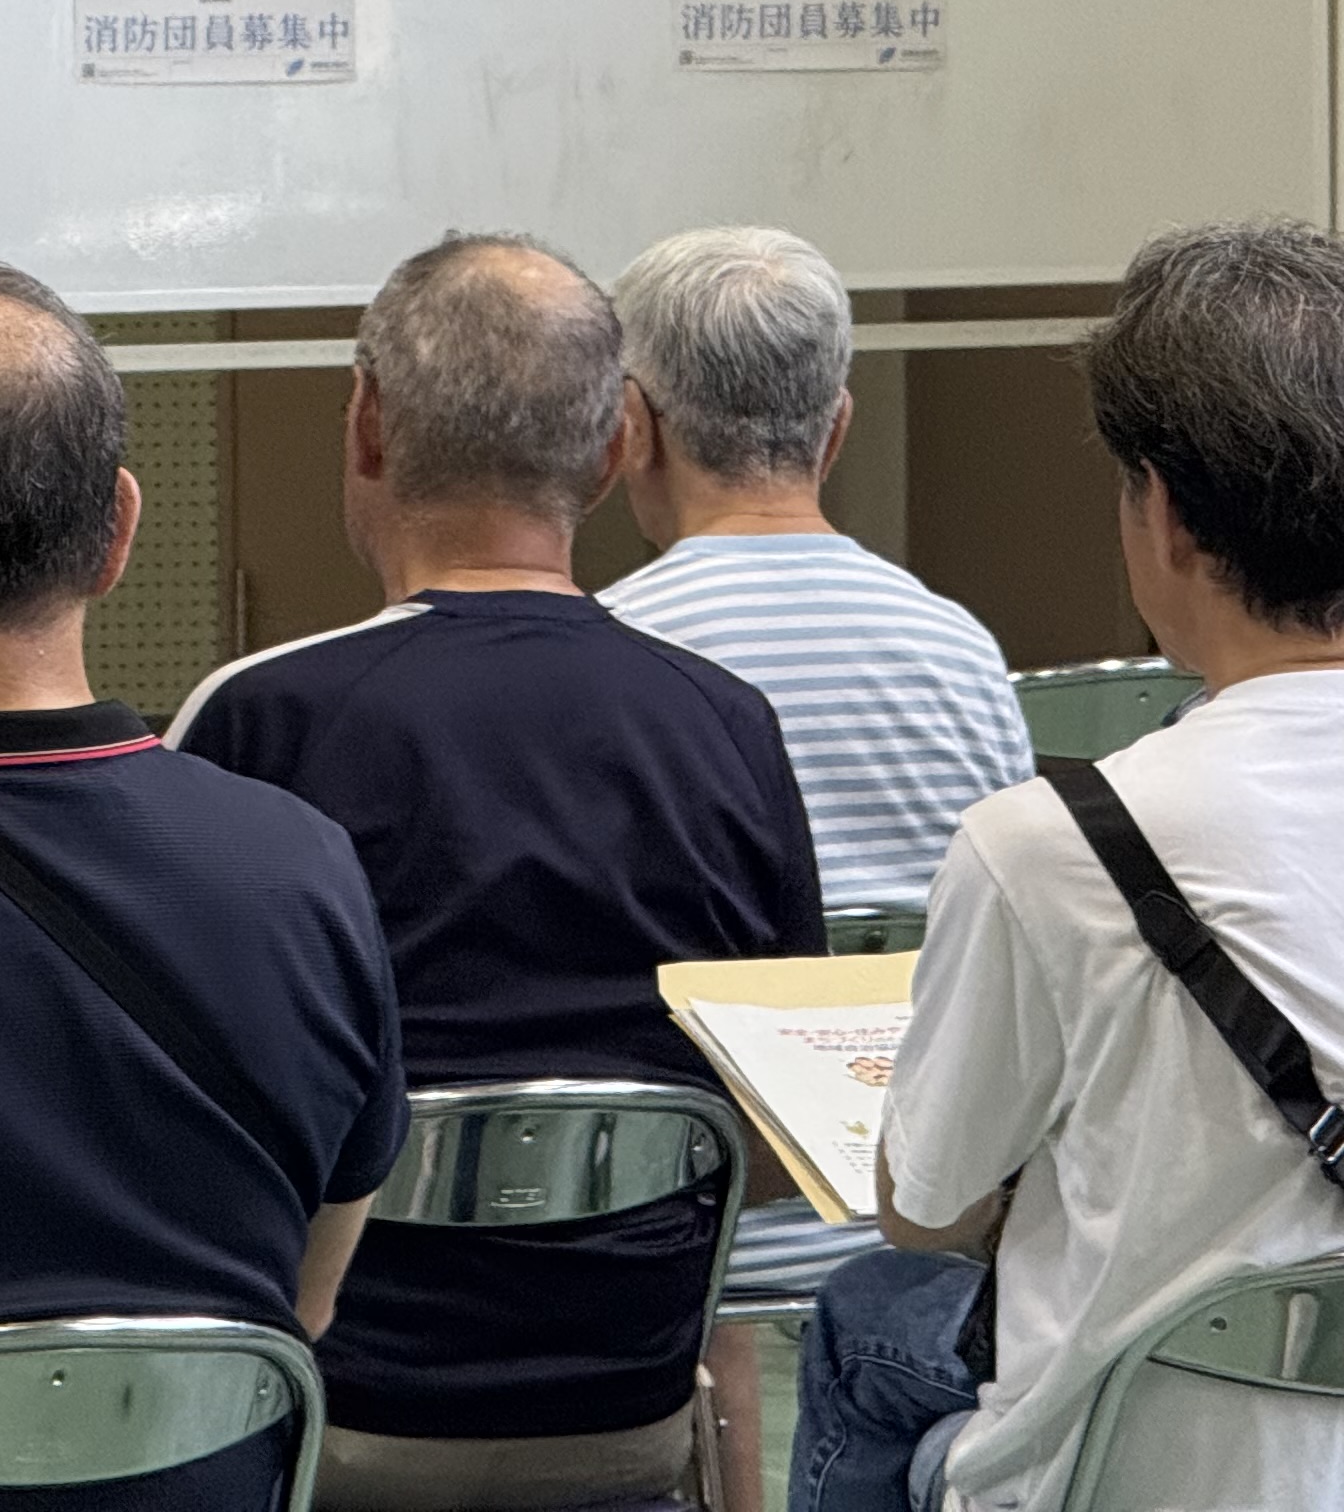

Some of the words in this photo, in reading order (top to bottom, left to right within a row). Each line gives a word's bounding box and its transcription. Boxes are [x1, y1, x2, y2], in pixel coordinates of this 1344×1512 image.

[85, 12, 350, 53] 消防団員募集中
[681, 0, 940, 39] 消防団員募集中
